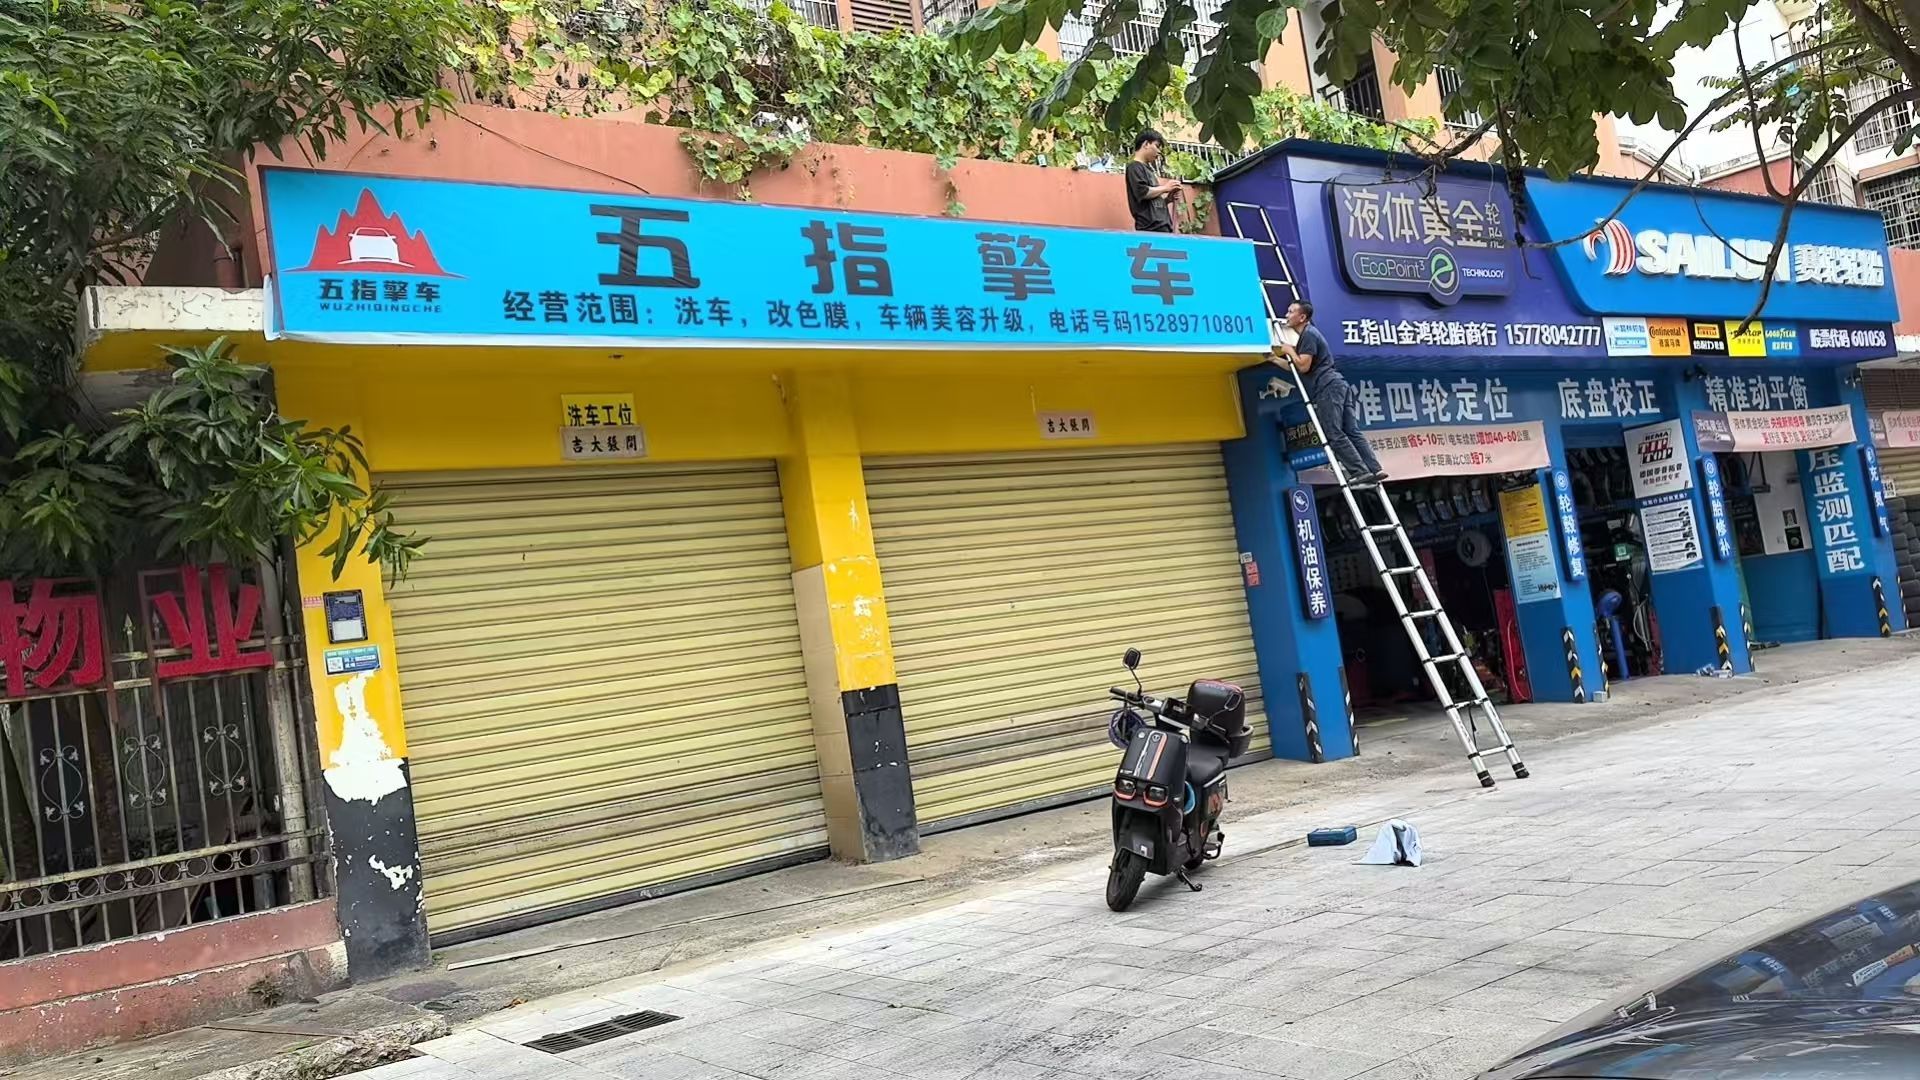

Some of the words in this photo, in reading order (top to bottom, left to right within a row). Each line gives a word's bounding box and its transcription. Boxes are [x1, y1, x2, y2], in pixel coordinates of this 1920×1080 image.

[1343, 187, 1487, 248] 液体黄金
[589, 203, 1194, 306] 五指擎车
[1634, 229, 1791, 283] SAILUN
[1462, 268, 1504, 279] TECHNOLOGY
[318, 278, 441, 302] 五指擎车
[320, 302, 443, 314] WUZHIQINGCHE
[1342, 318, 1497, 346] 五指山金鸿轮胎商行
[1504, 323, 1601, 346] 15778042777
[1649, 325, 1681, 339] Continental
[1809, 328, 1850, 348] 股票代码
[1851, 329, 1887, 347] 601058
[1350, 377, 1514, 426] 准四轮定位
[1557, 377, 1661, 419] 底盘校正
[1704, 375, 1810, 412] 精准动平衡
[567, 403, 634, 427] 洗车工位
[1643, 448, 1673, 464] TOP
[1297, 519, 1327, 614] 机油保养
[0, 562, 273, 697] 物业
